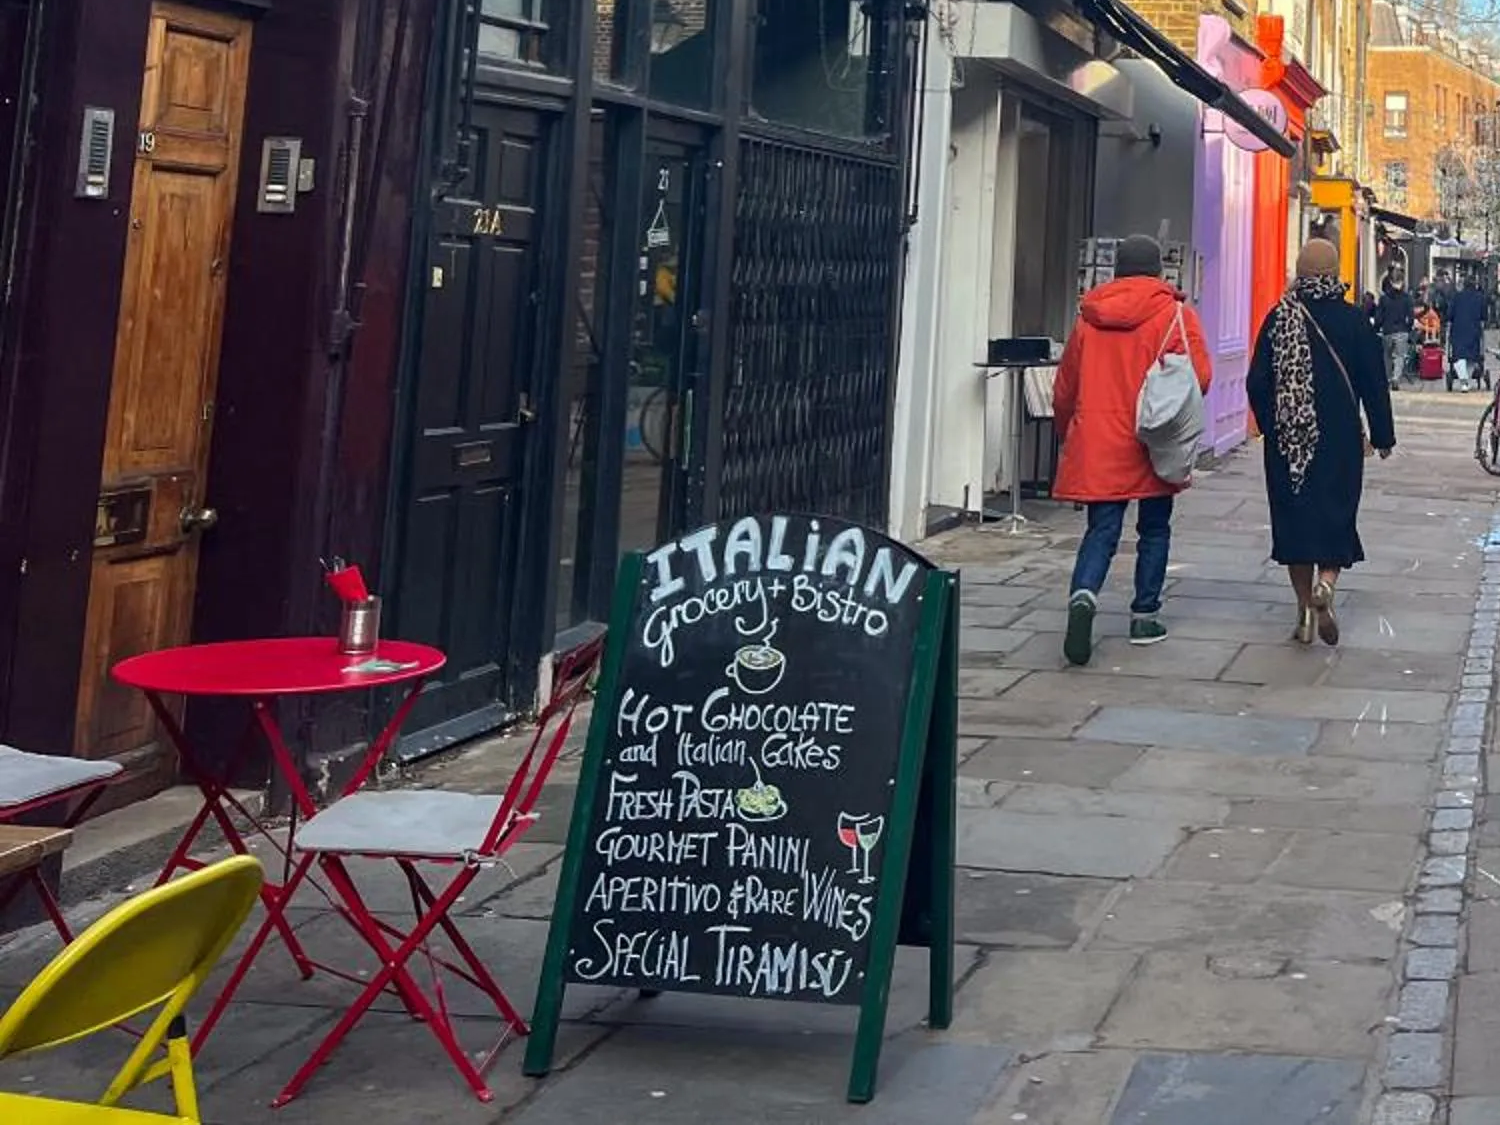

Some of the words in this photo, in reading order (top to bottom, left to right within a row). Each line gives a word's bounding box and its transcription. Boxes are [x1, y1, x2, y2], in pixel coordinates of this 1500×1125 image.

[139, 132, 155, 152] 19
[473, 208, 503, 236] 21A
[642, 575, 768, 668] Grocery
[790, 573, 889, 636] Bistro
[617, 687, 694, 737] HOT
[701, 687, 856, 734] CHOCOLATE
[619, 733, 657, 767] and
[677, 732, 747, 767] Italian
[761, 732, 841, 770] Cakes
[605, 770, 674, 822] FRESH
[672, 770, 735, 822] PASTA
[595, 826, 719, 867] GOURMET
[725, 822, 810, 875] PANINI
[801, 869, 872, 942] WINES
